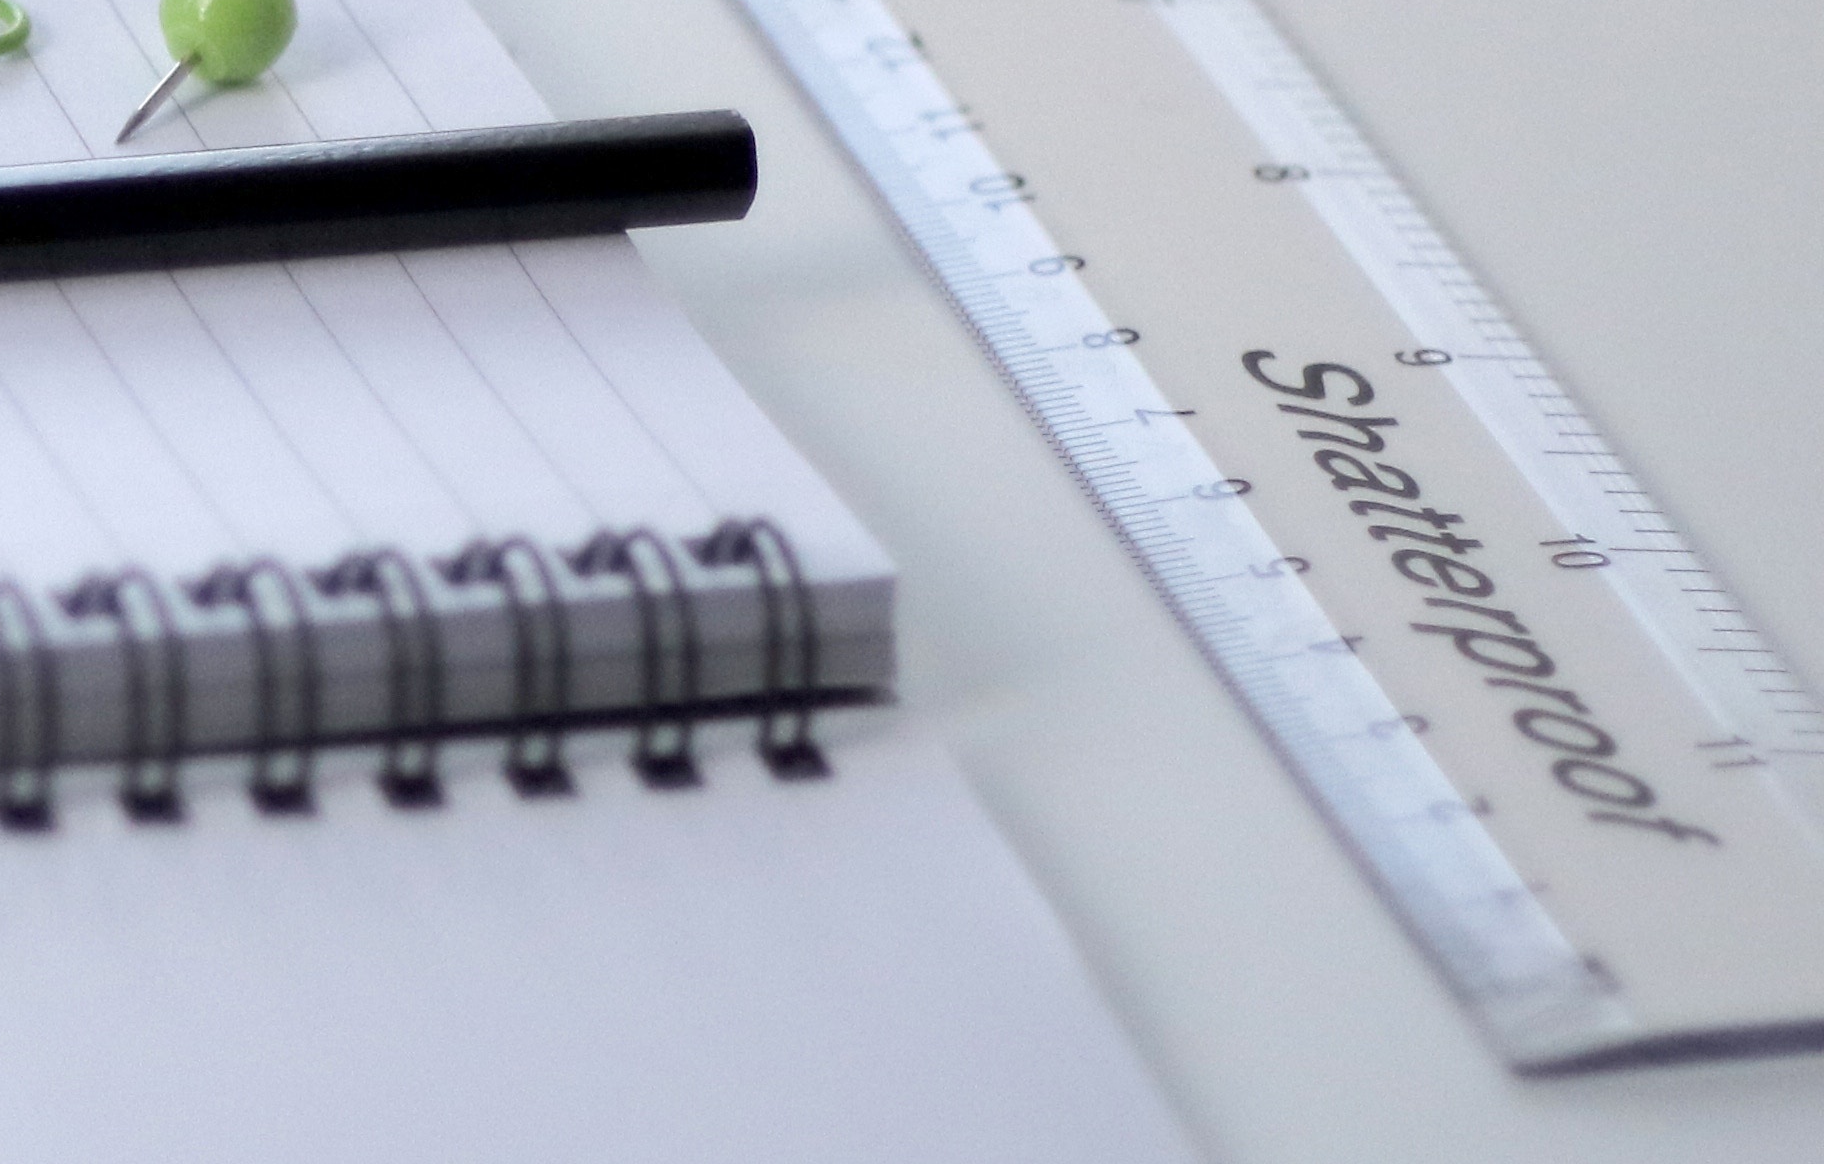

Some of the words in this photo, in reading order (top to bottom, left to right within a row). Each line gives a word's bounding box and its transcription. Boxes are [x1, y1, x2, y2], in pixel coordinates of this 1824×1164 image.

[1254, 163, 1310, 183] 8
[969, 173, 1036, 213] 10
[1028, 254, 1087, 277] 9
[1082, 326, 1141, 349] 8
[1394, 348, 1453, 367] 9
[1134, 407, 1197, 427] 7
[1192, 477, 1253, 501] 6
[1539, 532, 1612, 570] 10
[1248, 555, 1312, 579] 5
[1241, 348, 1722, 846] Shatterproof
[1366, 713, 1431, 739] 3
[1695, 735, 1768, 771] 11
